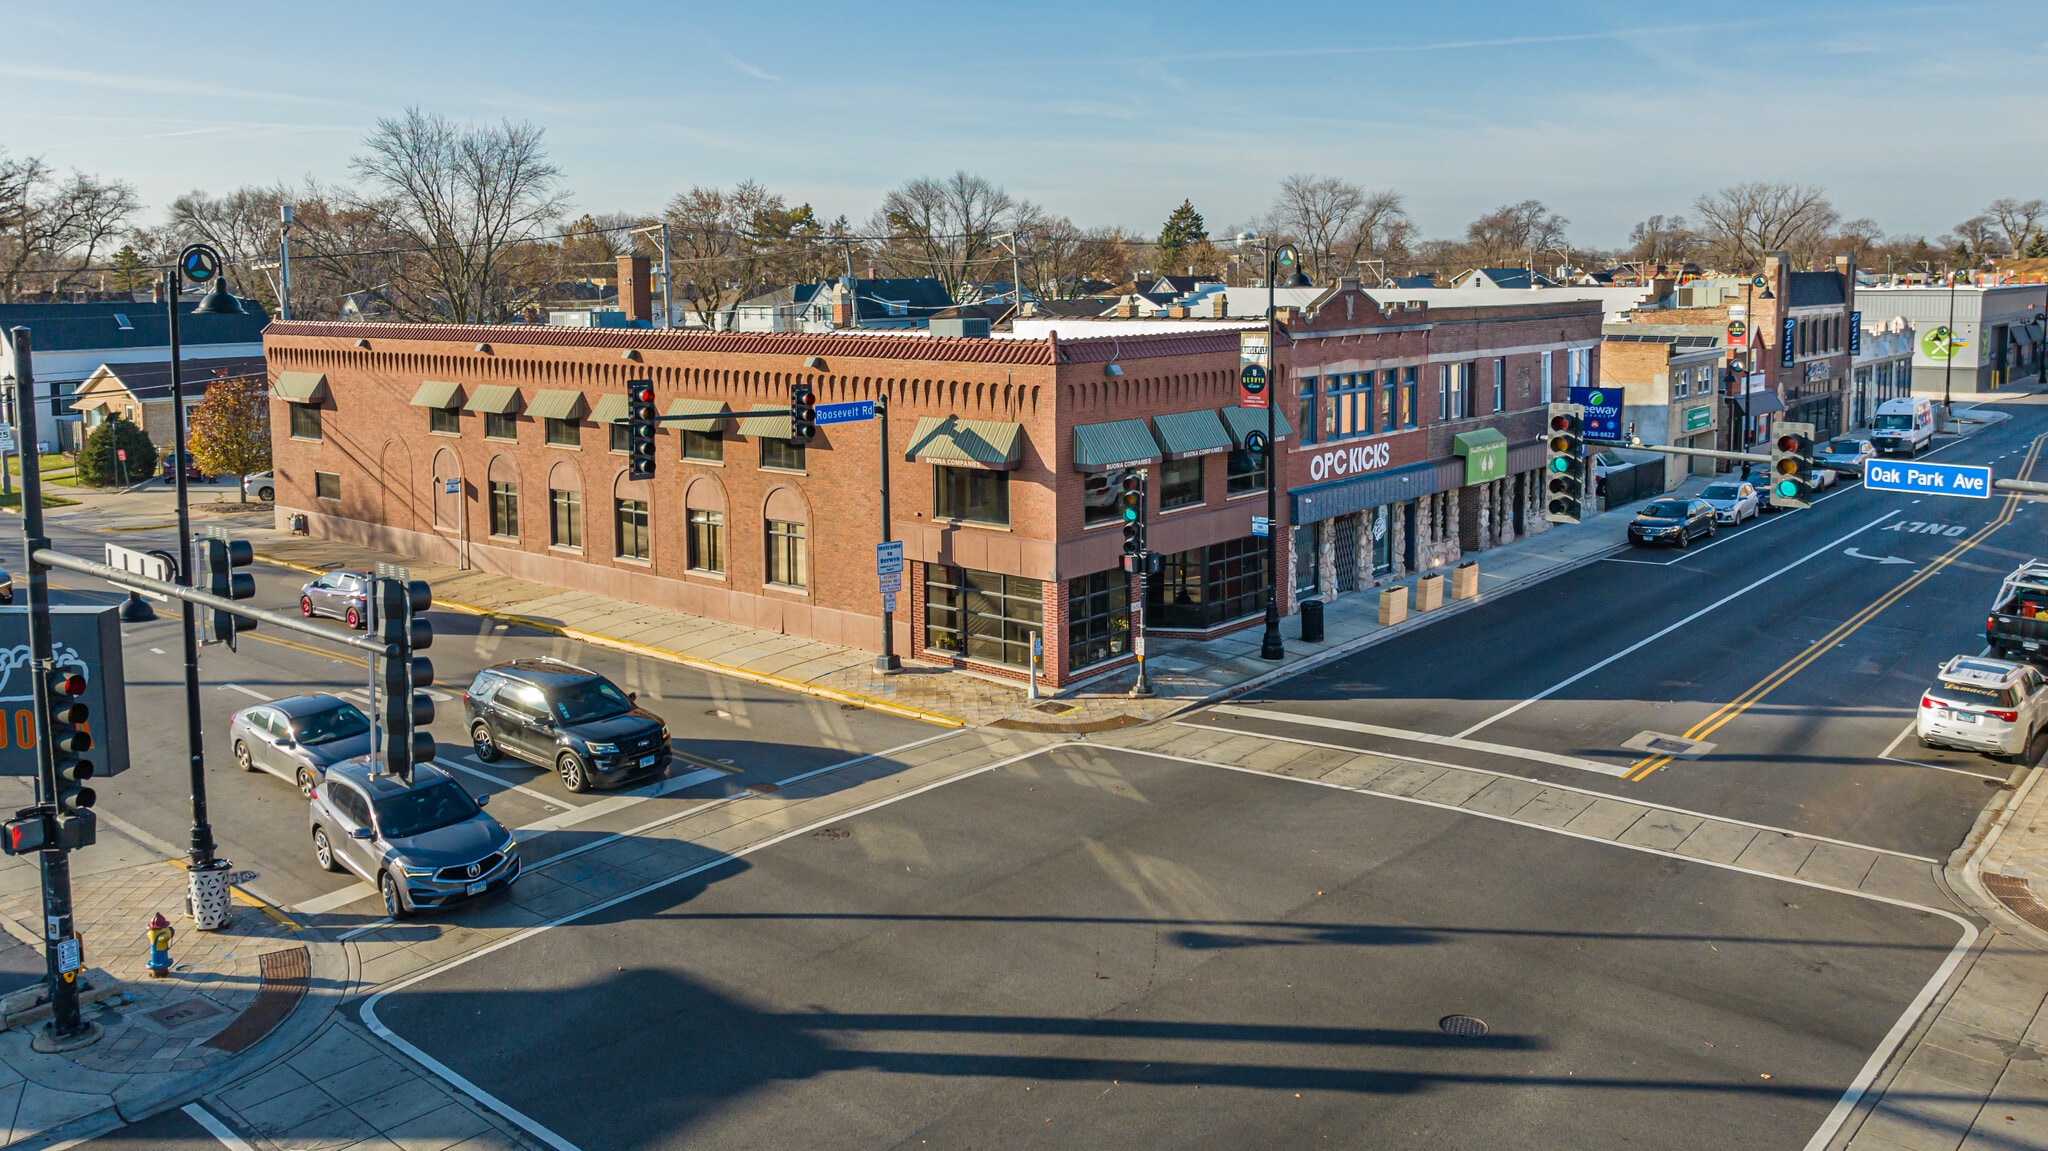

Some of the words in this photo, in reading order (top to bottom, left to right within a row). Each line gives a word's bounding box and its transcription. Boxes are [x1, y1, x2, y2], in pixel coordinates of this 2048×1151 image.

[816, 407, 859, 420] Roosevelt
[862, 406, 873, 416] Rd
[1584, 405, 1618, 417] eeway
[1183, 450, 1199, 458] BUONA
[1199, 446, 1223, 456] COMPANIES
[926, 457, 946, 465] BUONA
[947, 458, 980, 468] COMPANIES
[1106, 462, 1124, 471] BUONA
[1124, 457, 1152, 468] COMPANIES
[1310, 449, 1347, 481] OPC
[1349, 442, 1390, 474] KICKS
[1871, 466, 1901, 484] Oak
[1907, 469, 1944, 487] Park
[1953, 473, 1984, 490] Ave
[1881, 520, 1967, 537] ONLY
